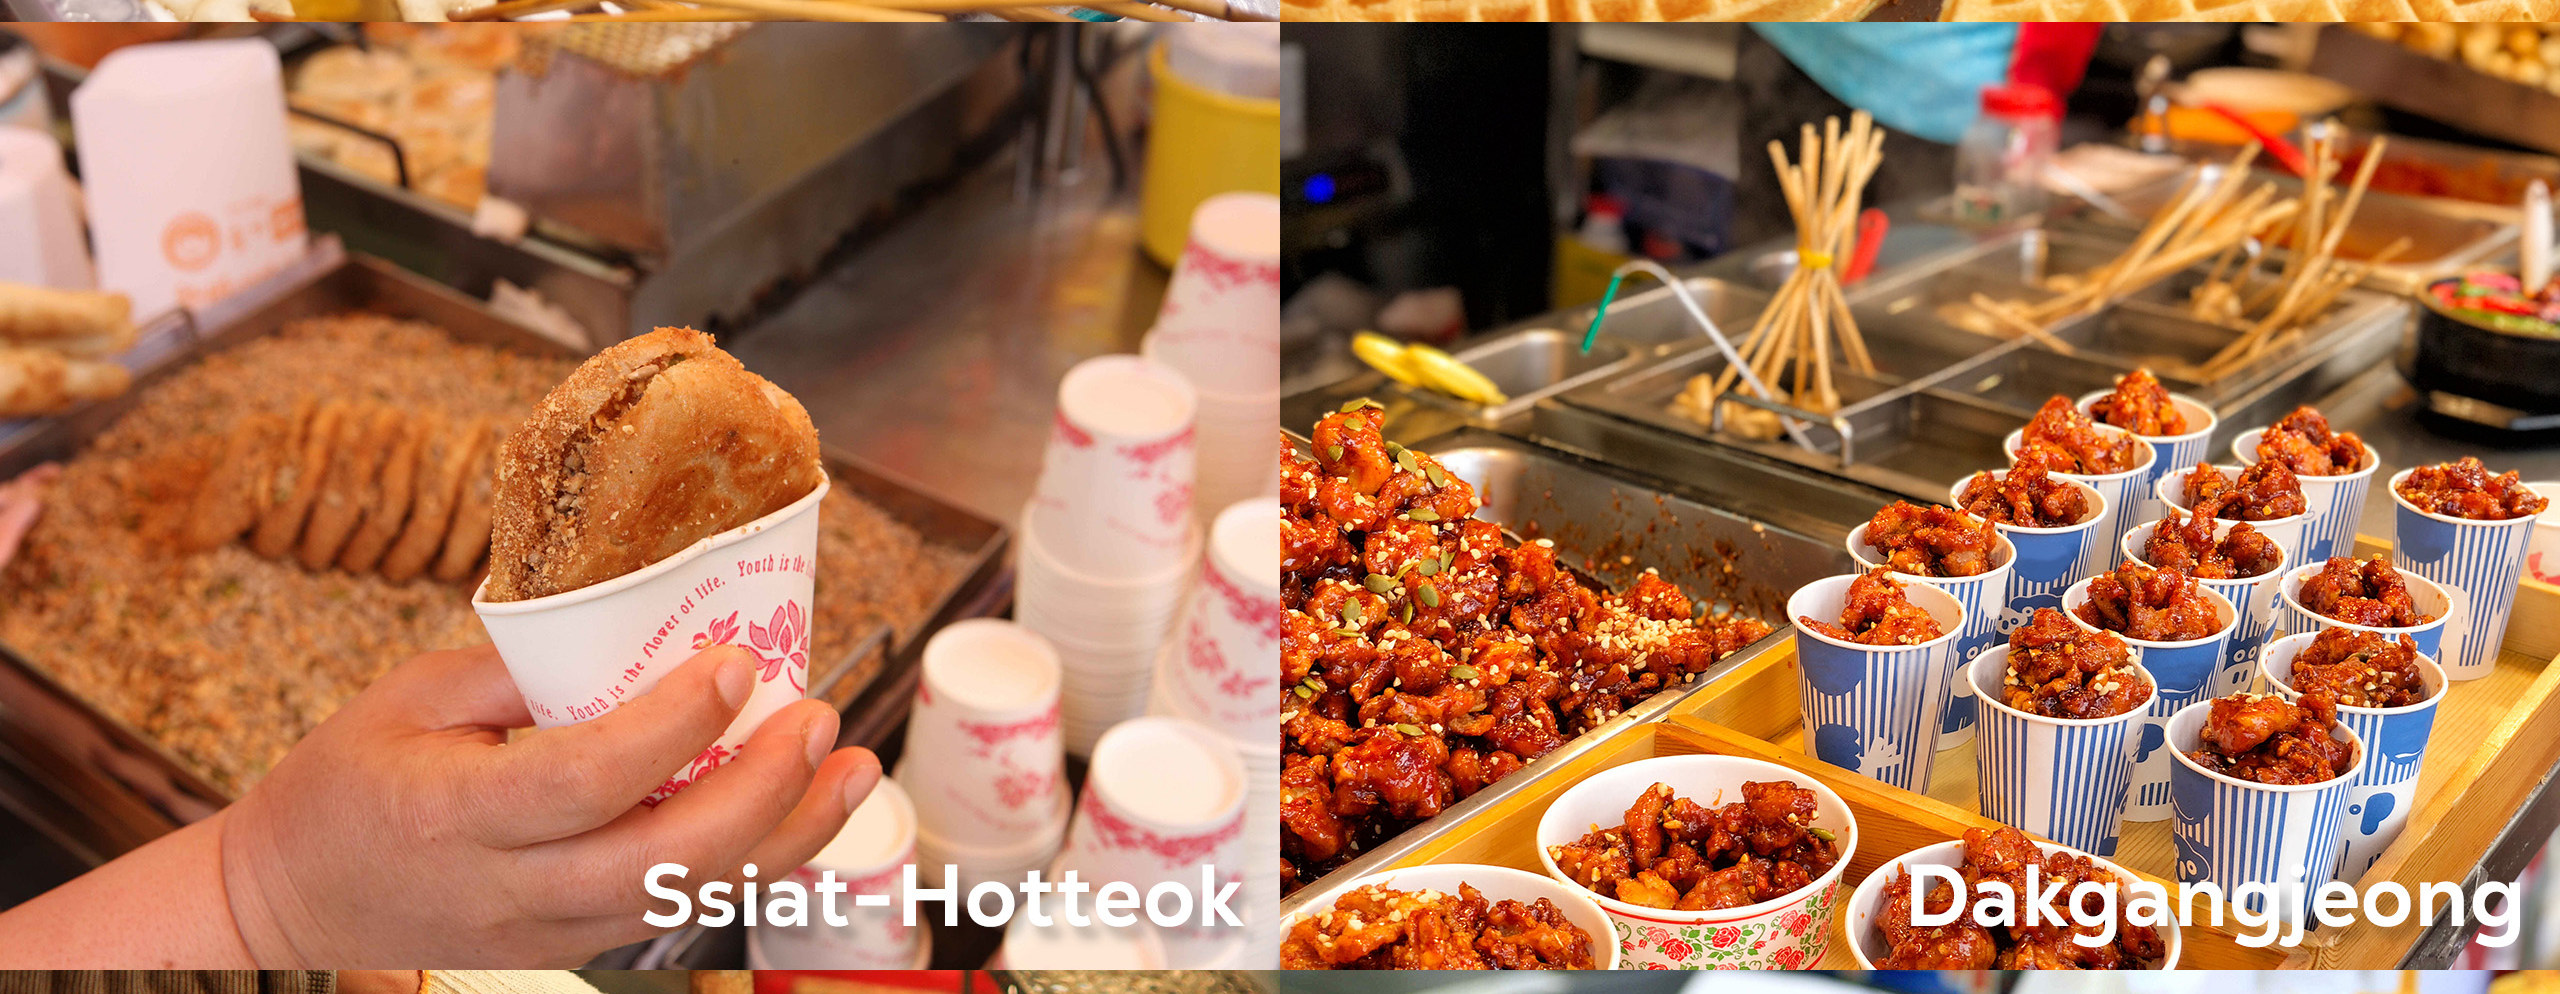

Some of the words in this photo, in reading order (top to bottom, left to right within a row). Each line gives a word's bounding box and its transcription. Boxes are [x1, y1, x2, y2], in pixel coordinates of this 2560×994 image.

[737, 553, 774, 577] Youth
[779, 553, 789, 573] is
[566, 697, 609, 720] Youth
[606, 685, 625, 700] is
[623, 662, 645, 683] the
[642, 614, 680, 658] flower
[680, 595, 695, 614] of
[695, 577, 726, 600] life.
